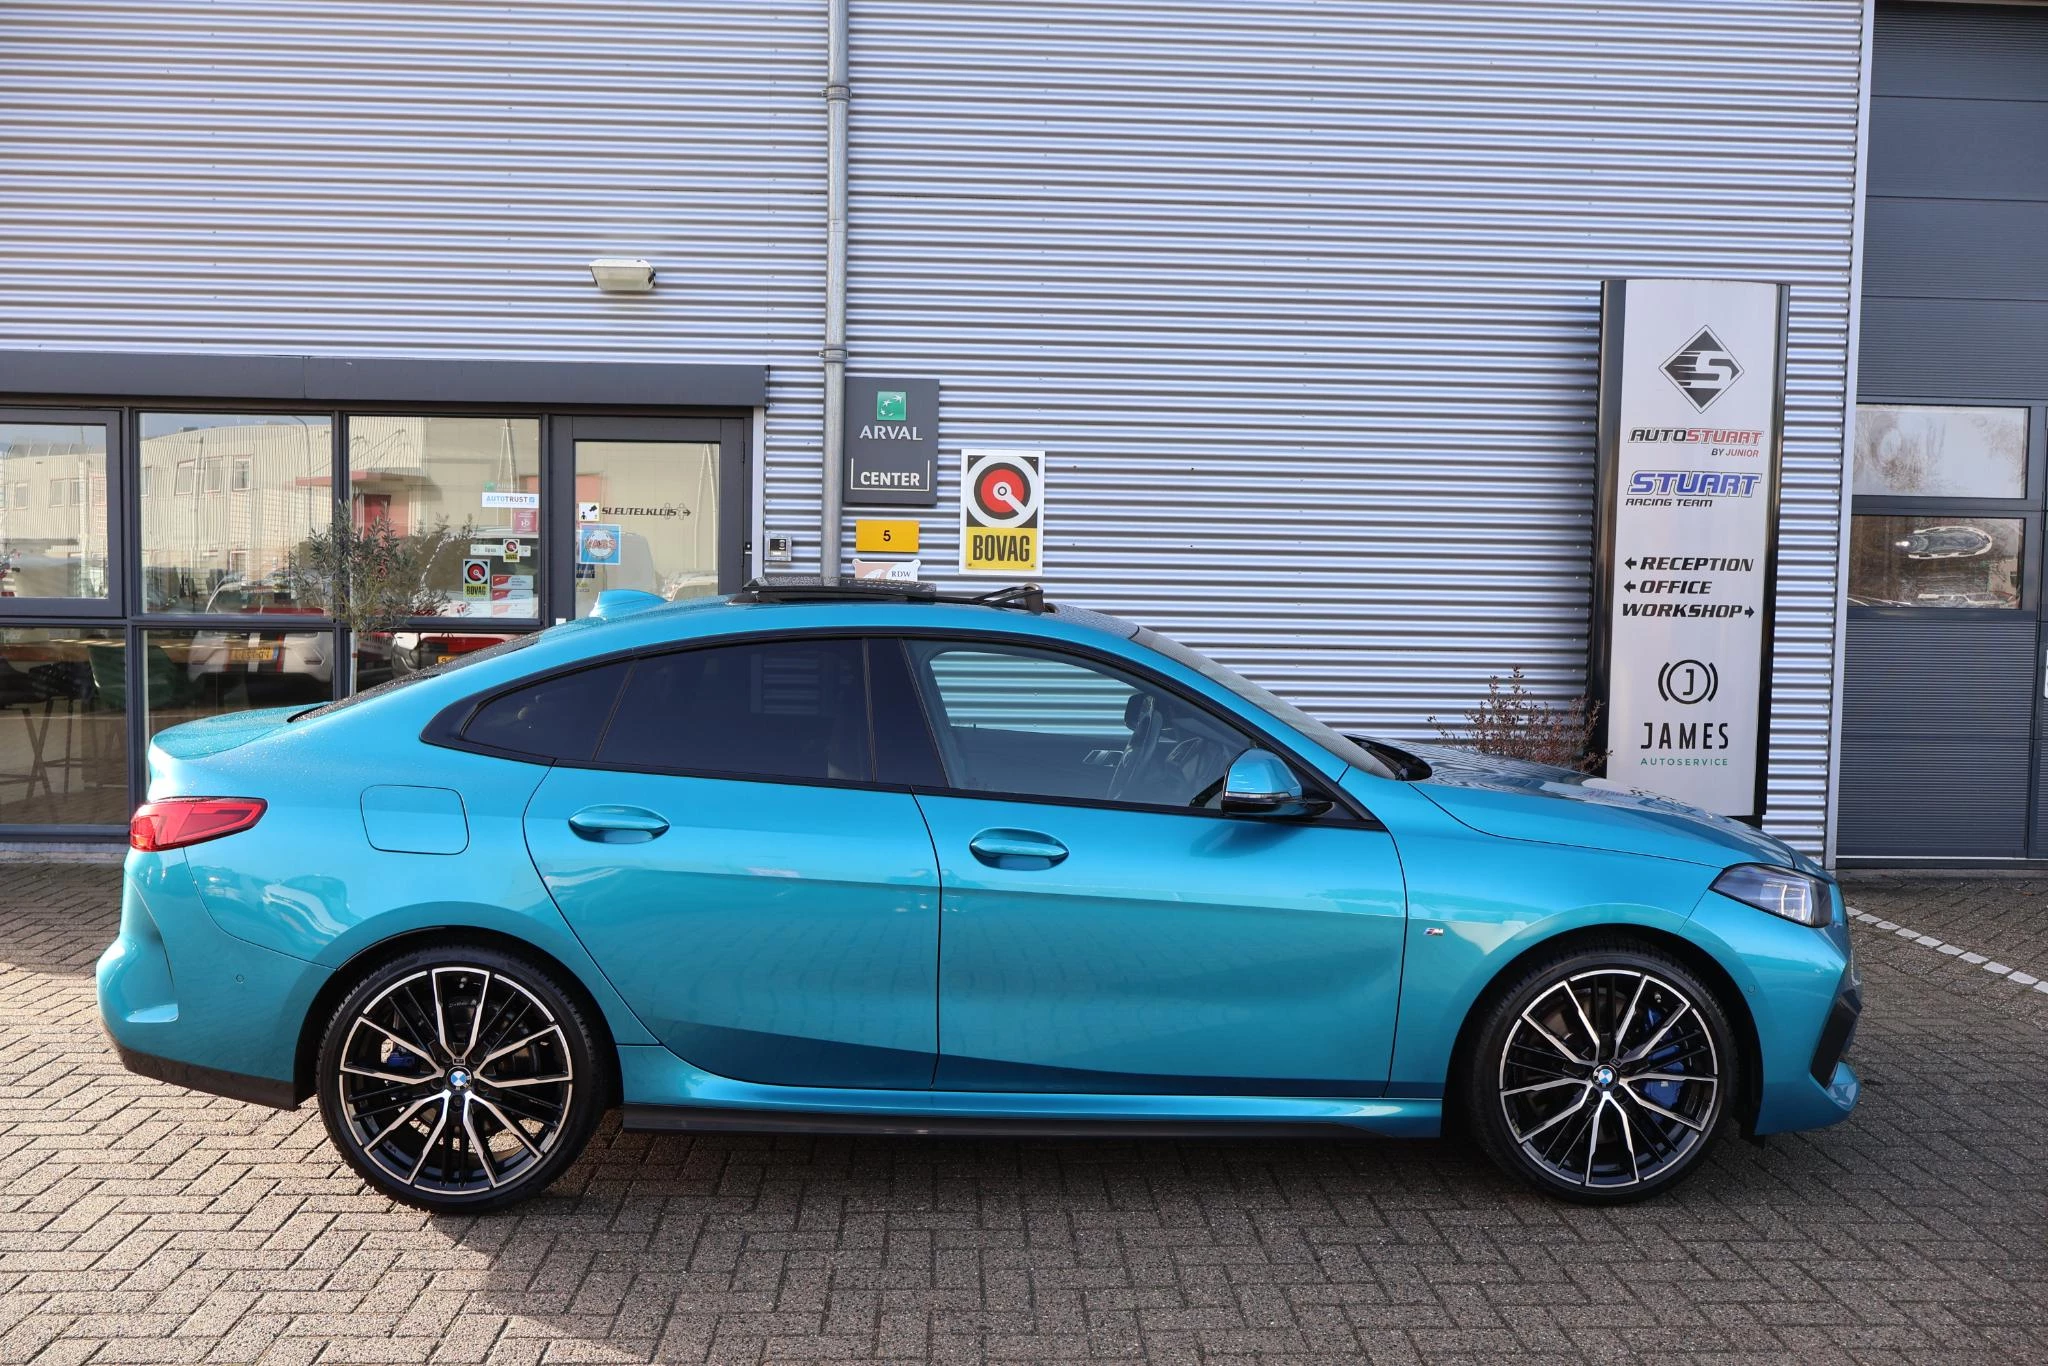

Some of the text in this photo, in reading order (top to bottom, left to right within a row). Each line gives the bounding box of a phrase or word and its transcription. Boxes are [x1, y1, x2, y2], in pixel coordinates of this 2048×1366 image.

[859, 425, 923, 441] ARVAL
[1628, 427, 1764, 446] AUTOSTUART
[1711, 448, 1759, 458] BY JUNIOR
[860, 471, 920, 486] CENTER
[1627, 470, 1762, 497] STUART
[486, 495, 528, 503] AUTOTRUST
[1625, 498, 1713, 508] RACING TEAM
[601, 506, 677, 516] SLEUTELKLUIS
[882, 530, 891, 542] 5
[973, 534, 1030, 562] BOVAG
[1640, 556, 1754, 572] RECEPTION
[891, 570, 912, 578] RDW
[466, 585, 486, 596] BOVAG
[1639, 580, 1713, 594] OFFICE
[1622, 603, 1743, 618] WORKSHOP
[1640, 722, 1729, 750] JAMES
[1640, 757, 1728, 766] AUTOSERVICE
